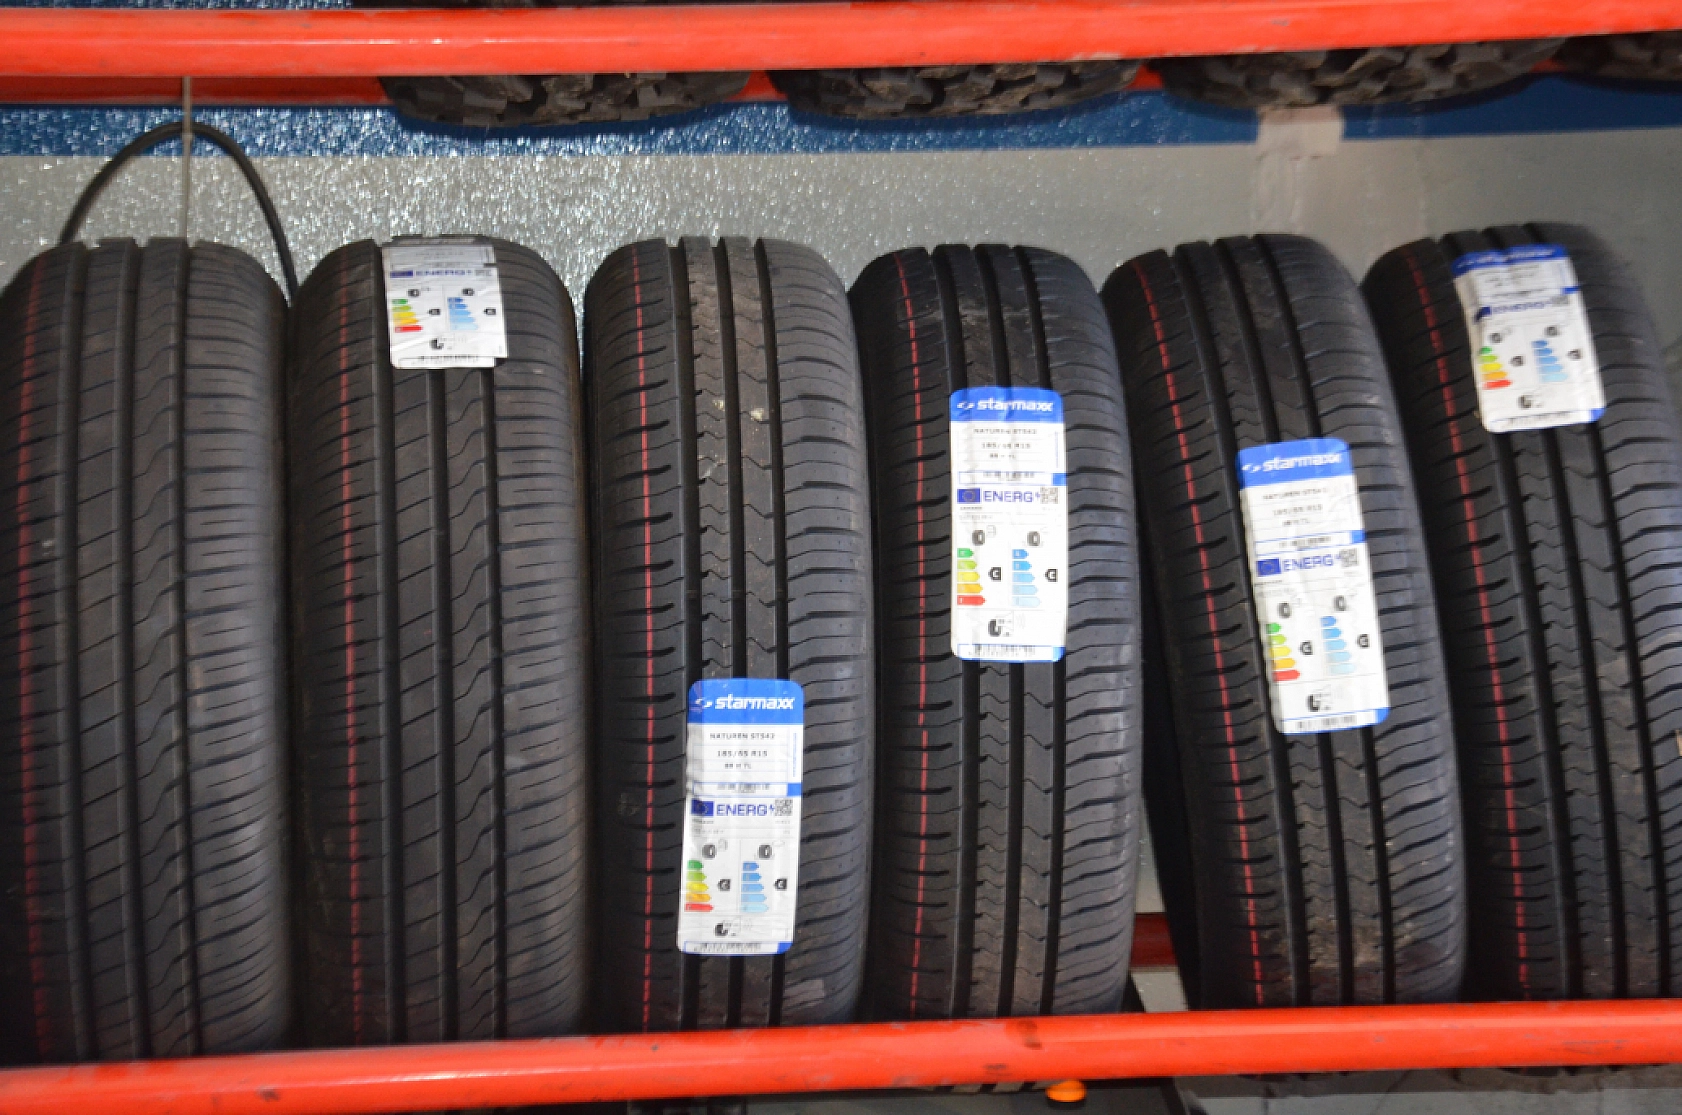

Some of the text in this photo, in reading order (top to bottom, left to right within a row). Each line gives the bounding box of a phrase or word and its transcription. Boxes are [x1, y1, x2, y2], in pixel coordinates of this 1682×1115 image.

[976, 397, 1054, 412] starmaxx
[1262, 452, 1342, 472] starmaxx
[982, 490, 1034, 503] ENERG
[714, 693, 796, 710] starmaxx
[716, 803, 768, 817] ENERG
